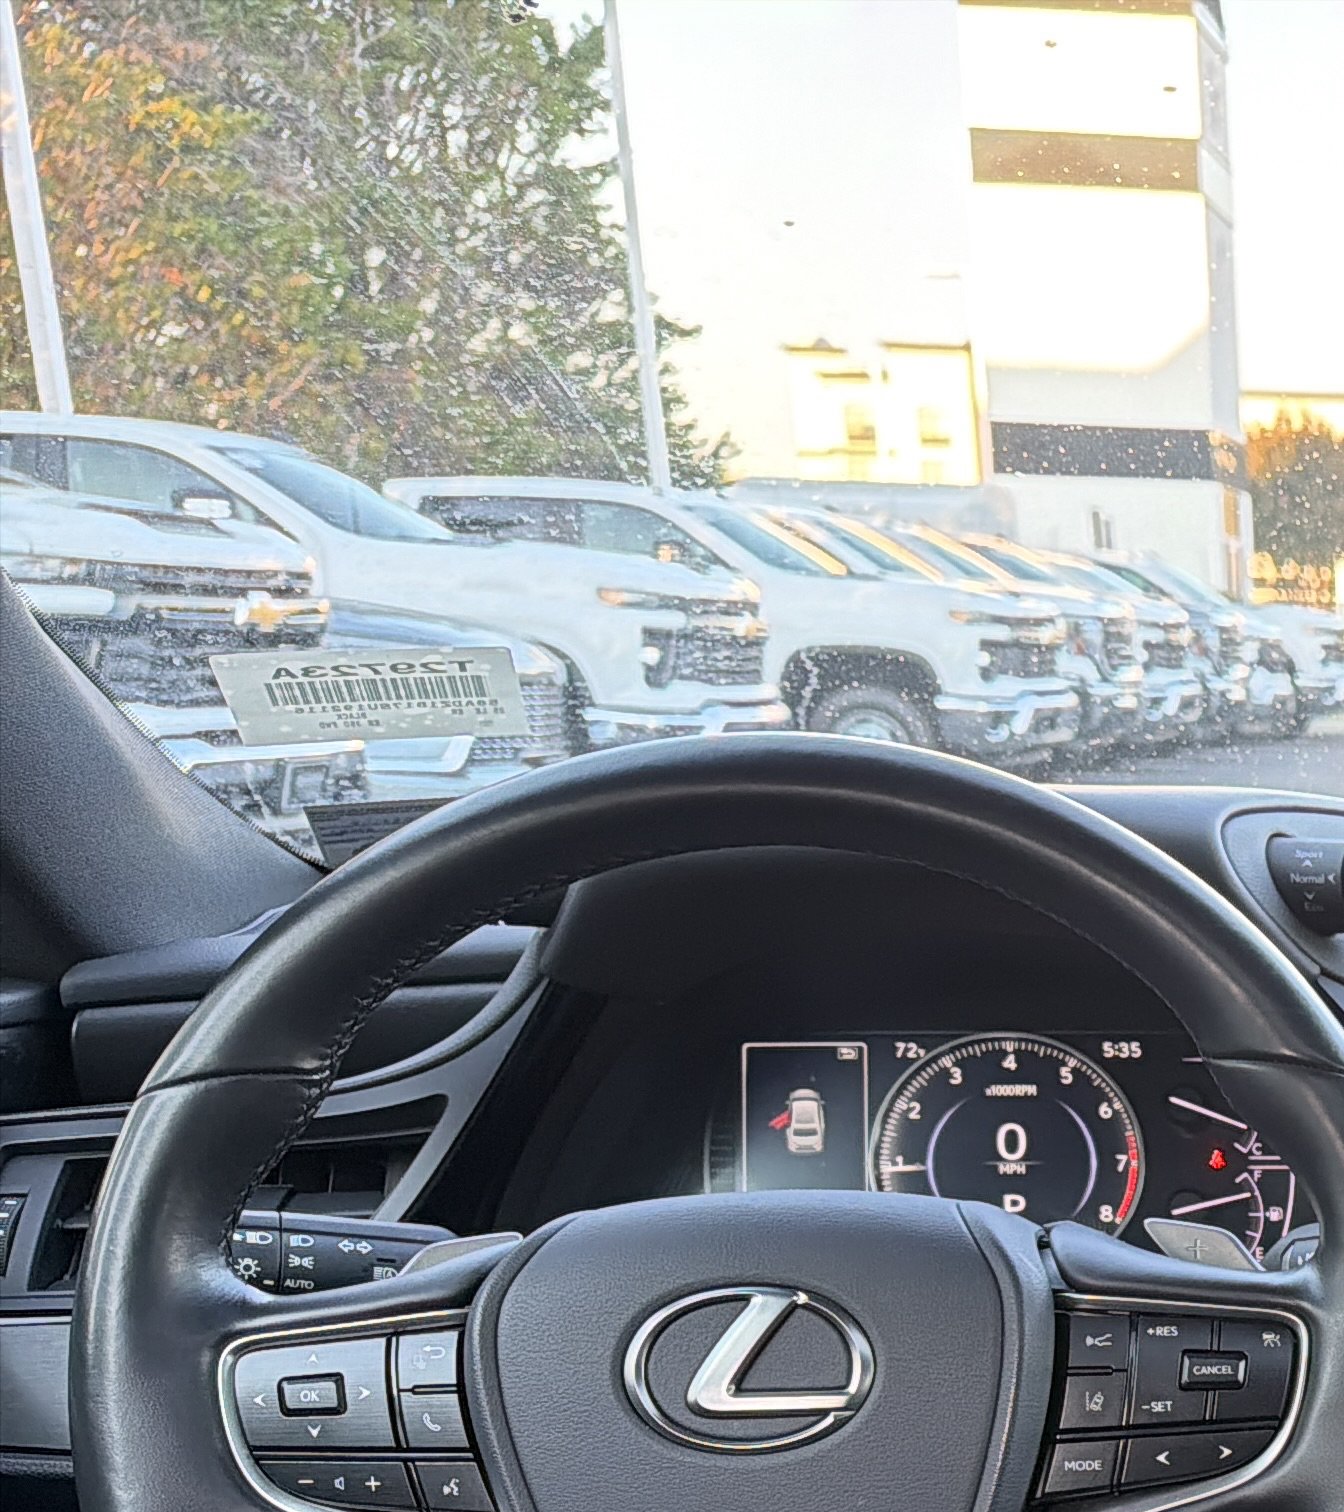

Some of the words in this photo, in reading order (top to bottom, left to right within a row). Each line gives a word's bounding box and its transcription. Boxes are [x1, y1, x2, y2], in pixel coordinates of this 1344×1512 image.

[1290, 872, 1326, 884] Normal
[1103, 1041, 1141, 1058] 5:35
[1002, 1053, 1017, 1071] 4
[950, 1067, 962, 1085] 3
[1059, 1067, 1073, 1085] 5
[908, 1102, 921, 1120] 2
[1098, 1102, 1113, 1119] 6
[996, 1123, 1027, 1161] 0
[1252, 1143, 1263, 1155] C
[999, 1163, 1026, 1175] MPH
[1115, 1154, 1128, 1173] 7
[1254, 1170, 1263, 1182] F
[1099, 1205, 1113, 1223] 8
[1255, 1247, 1265, 1262] E
[284, 1279, 315, 1290] AUTO
[1193, 1365, 1235, 1375] CANCEL
[300, 1390, 320, 1402] OK
[1064, 1460, 1103, 1471] MODE
